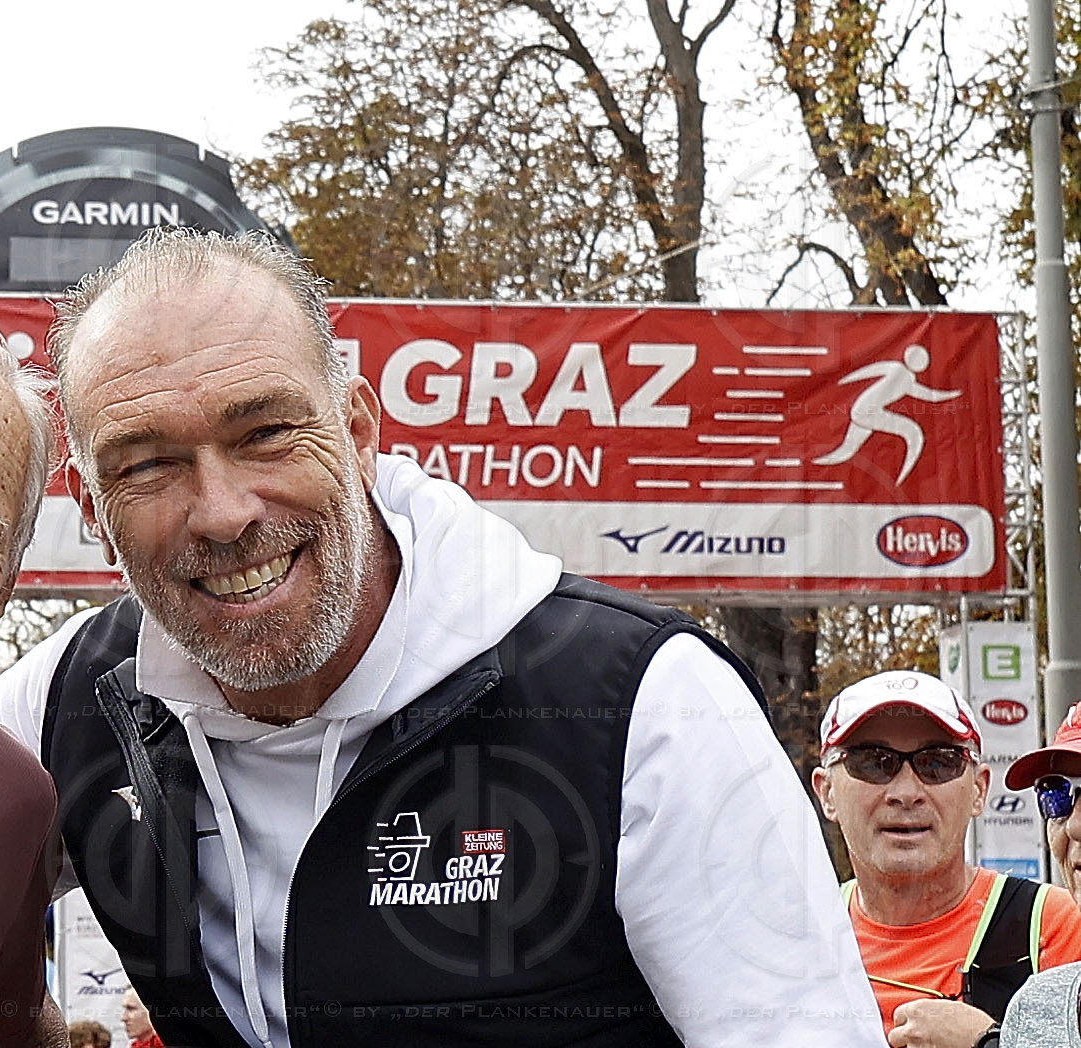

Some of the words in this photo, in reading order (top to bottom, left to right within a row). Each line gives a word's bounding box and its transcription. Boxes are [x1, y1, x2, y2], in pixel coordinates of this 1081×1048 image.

[32, 200, 179, 227] GARMIN
[379, 338, 698, 430] GRAZ
[391, 443, 603, 488] ATHON
[885, 526, 963, 556] Hervis
[464, 832, 503, 843] KLEINE
[464, 841, 503, 852] ZEITUNG
[445, 854, 505, 880] GRAZ
[369, 877, 500, 906] MARATHON
